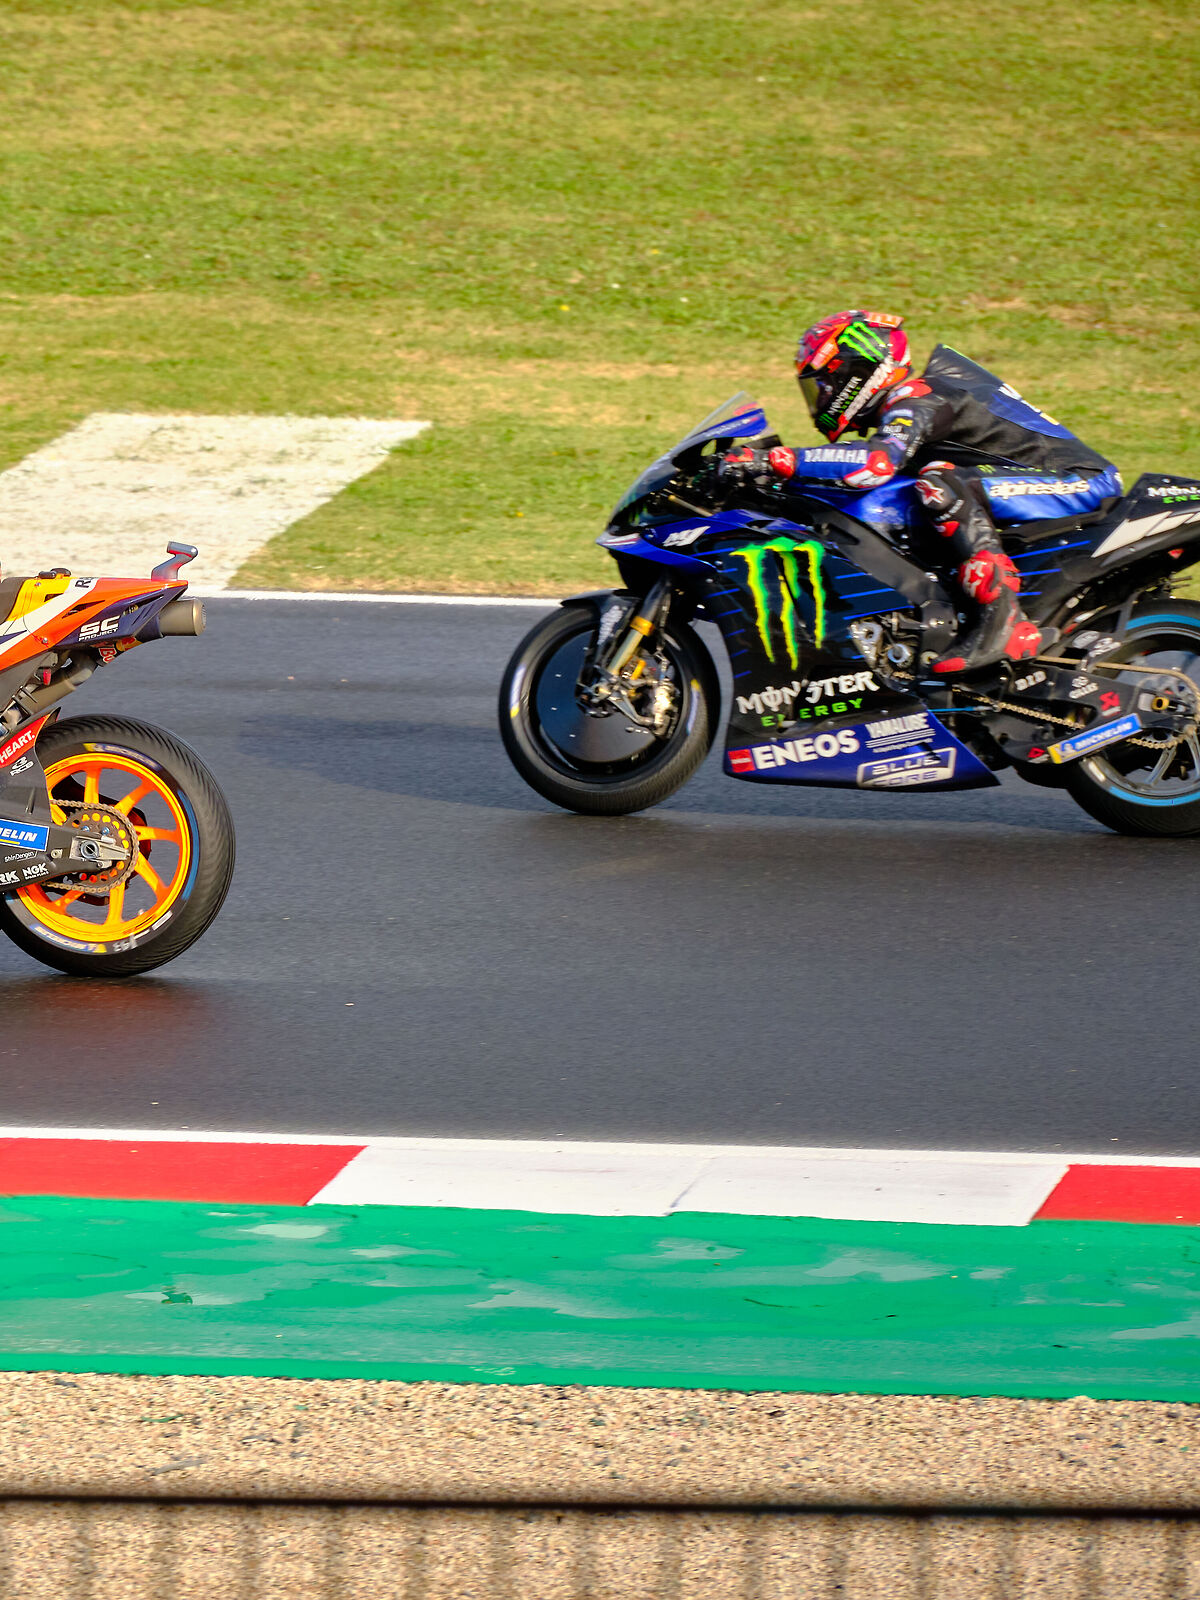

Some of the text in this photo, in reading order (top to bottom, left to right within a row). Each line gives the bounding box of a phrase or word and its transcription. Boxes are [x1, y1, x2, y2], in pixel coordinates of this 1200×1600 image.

[804, 449, 868, 464] YAMAHA
[990, 480, 1091, 499] alpinestars
[79, 615, 120, 637] SC
[79, 628, 118, 641] PROJECT
[736, 671, 880, 714] MONSTER
[752, 729, 860, 770] ENEOS
[872, 755, 941, 775] BLUE
[872, 771, 937, 785] CORE
[22, 863, 48, 876] NGK
